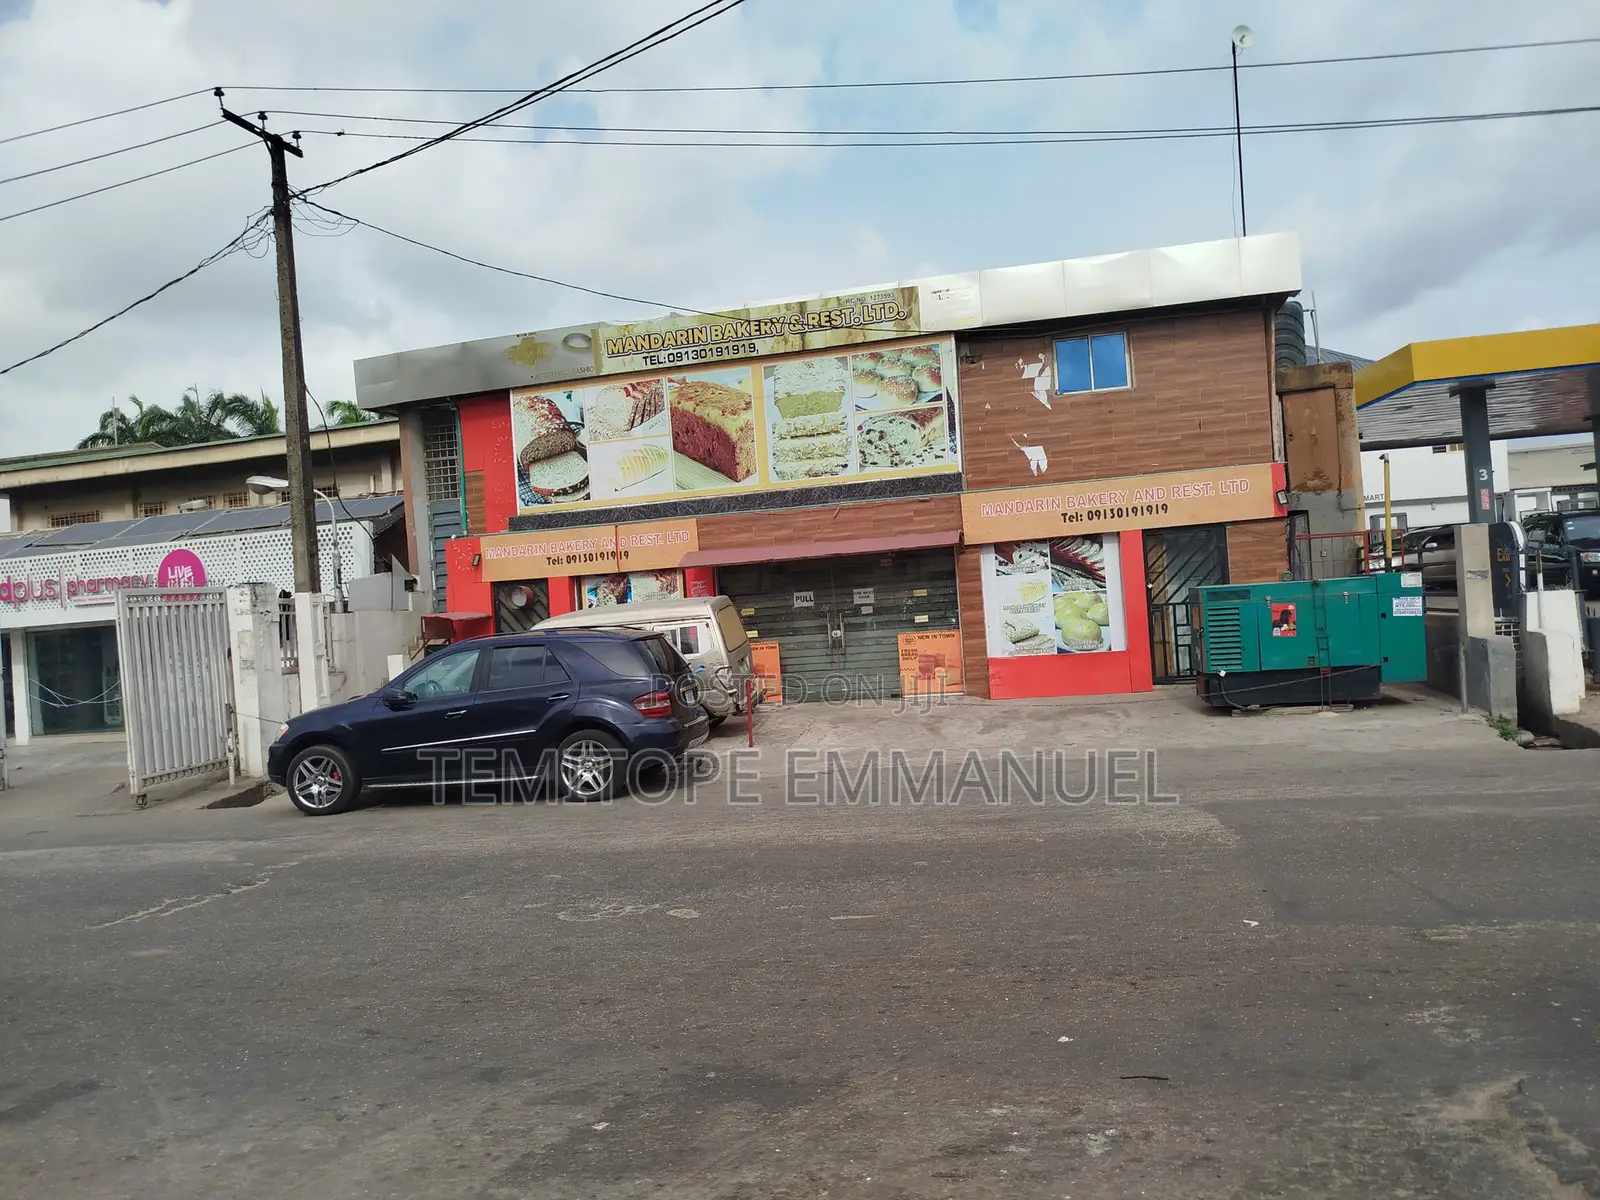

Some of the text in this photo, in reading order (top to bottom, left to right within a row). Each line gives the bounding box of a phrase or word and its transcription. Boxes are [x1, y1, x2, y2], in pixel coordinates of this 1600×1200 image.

[606, 326, 709, 358] MANDARIN
[709, 316, 785, 342] BAKERY
[787, 313, 806, 333] &
[1479, 469, 1489, 481] 3
[981, 479, 1251, 517] MANDARIN BAKERY AND REST. LTD
[1061, 503, 1168, 523] Tel: 09130191919
[485, 530, 689, 559] MANDARIN BAKERY AND REST. LTD
[546, 556, 563, 566] Tel:
[796, 594, 814, 603] PULL
